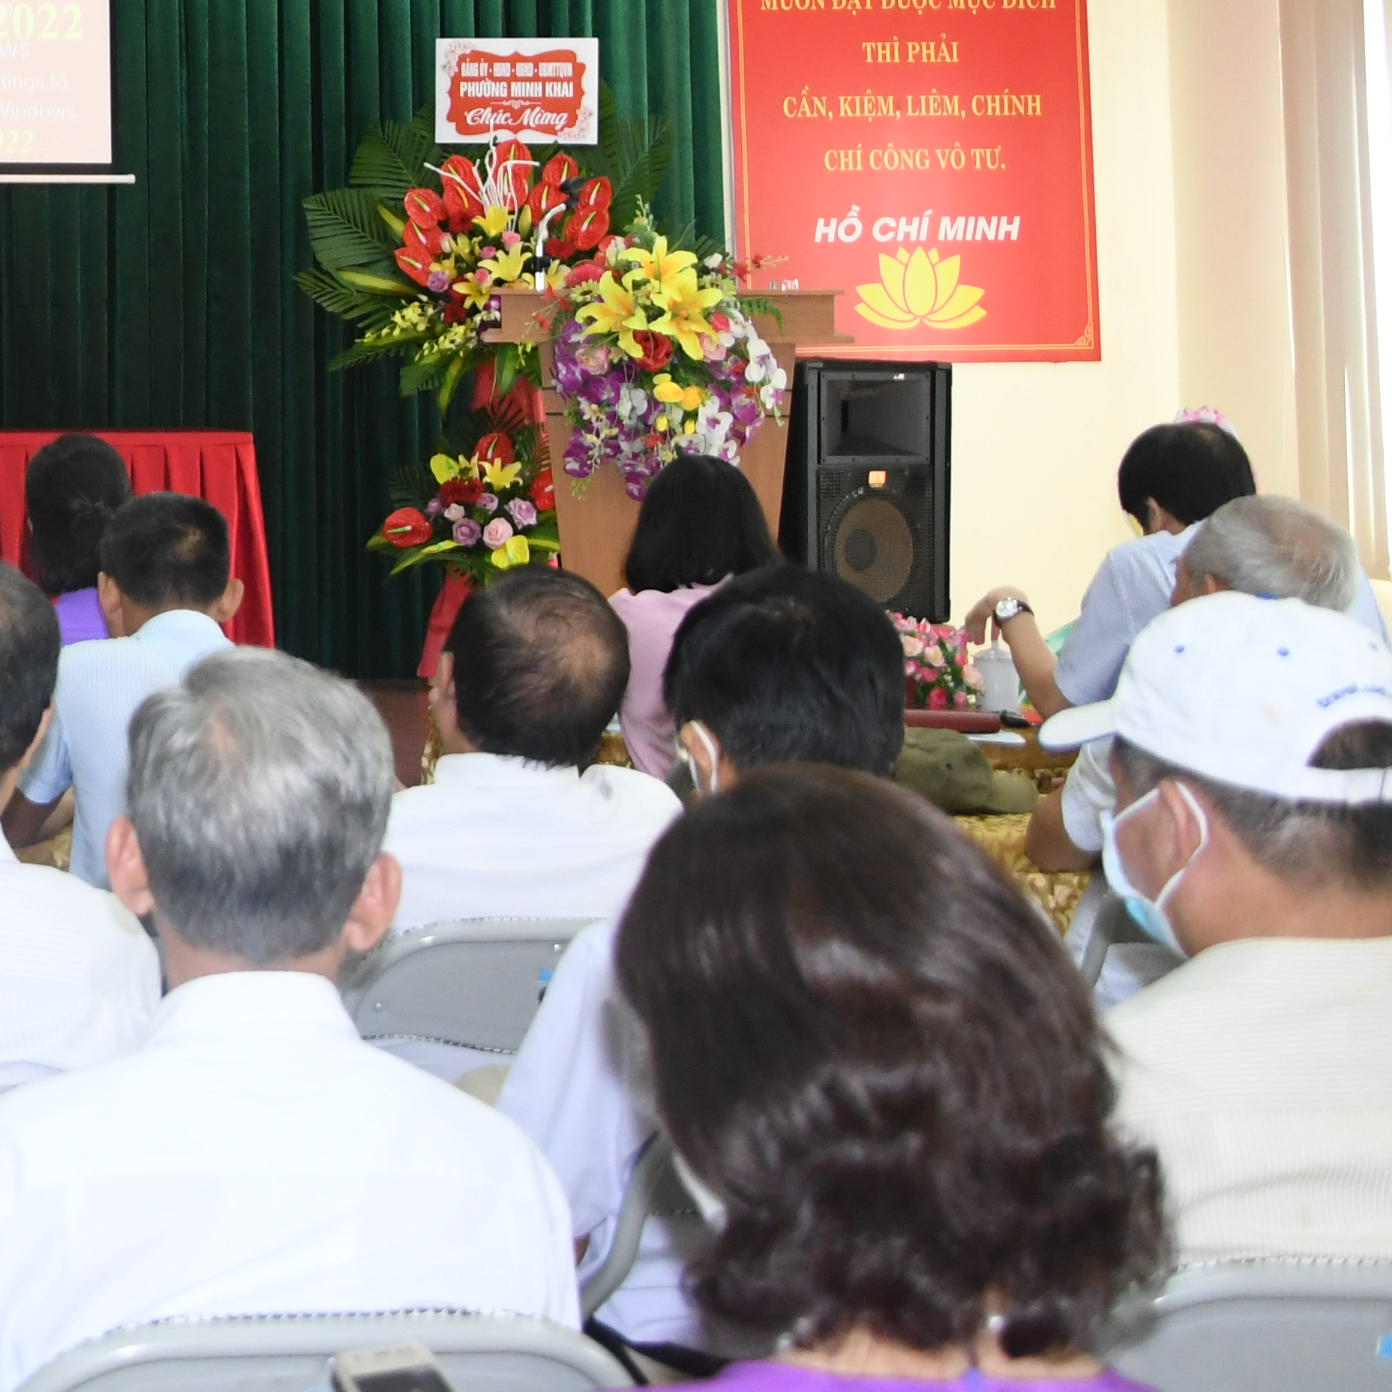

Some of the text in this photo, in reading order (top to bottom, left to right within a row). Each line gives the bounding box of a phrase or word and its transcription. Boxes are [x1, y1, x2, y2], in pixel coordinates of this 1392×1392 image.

[862, 33, 959, 63] THÌ PHẢI
[460, 78, 574, 98] PHƯỜNG MINH KHAI
[465, 106, 569, 130] Chúc Mừng
[783, 86, 1041, 122] CẦN, KIỆM, LIÊM, CHÍNH
[825, 142, 1005, 171] CHÍ CÔNG VÔ TƯ.
[815, 205, 1020, 243] HỒ CHÍ MINH
